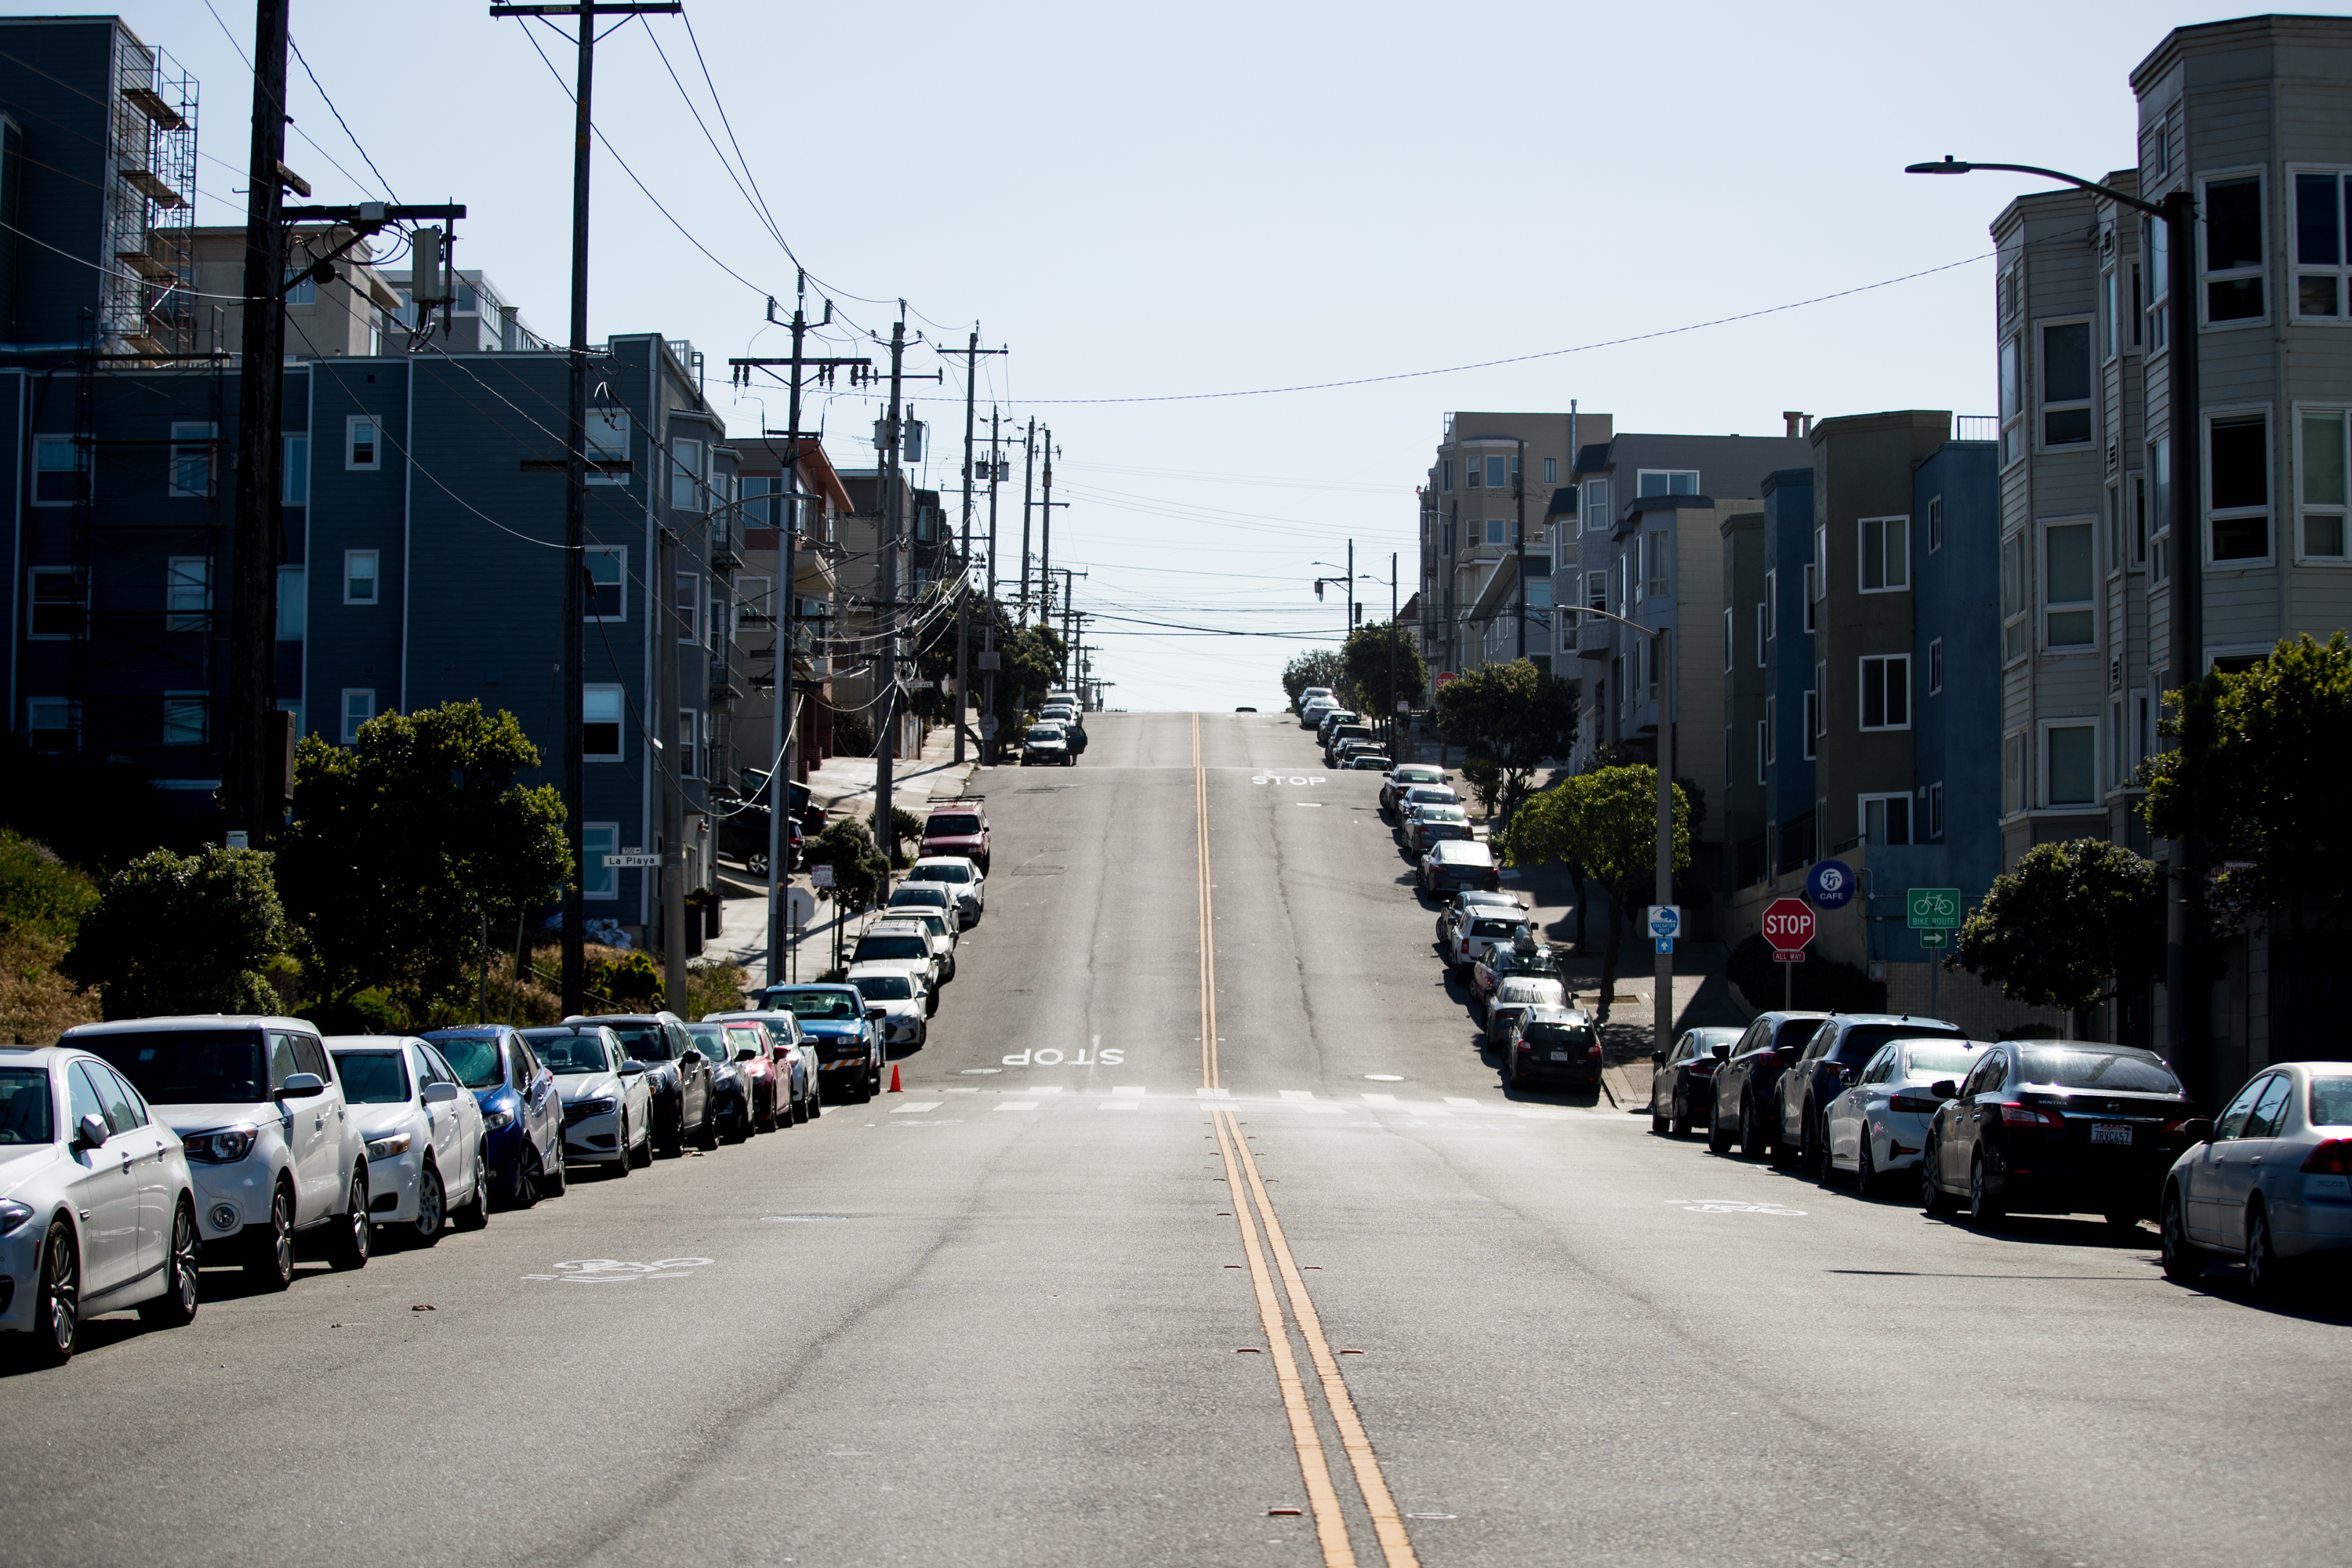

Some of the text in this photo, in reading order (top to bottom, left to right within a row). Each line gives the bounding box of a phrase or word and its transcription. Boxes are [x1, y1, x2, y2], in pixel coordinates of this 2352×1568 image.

[1252, 775, 1327, 786] STOP
[626, 857, 655, 866] Playa
[2210, 865, 2223, 877] NO
[1766, 914, 1811, 935] STOP
[1002, 1048, 1124, 1066] STOP
[2094, 1130, 2129, 1142] 7RVC457
